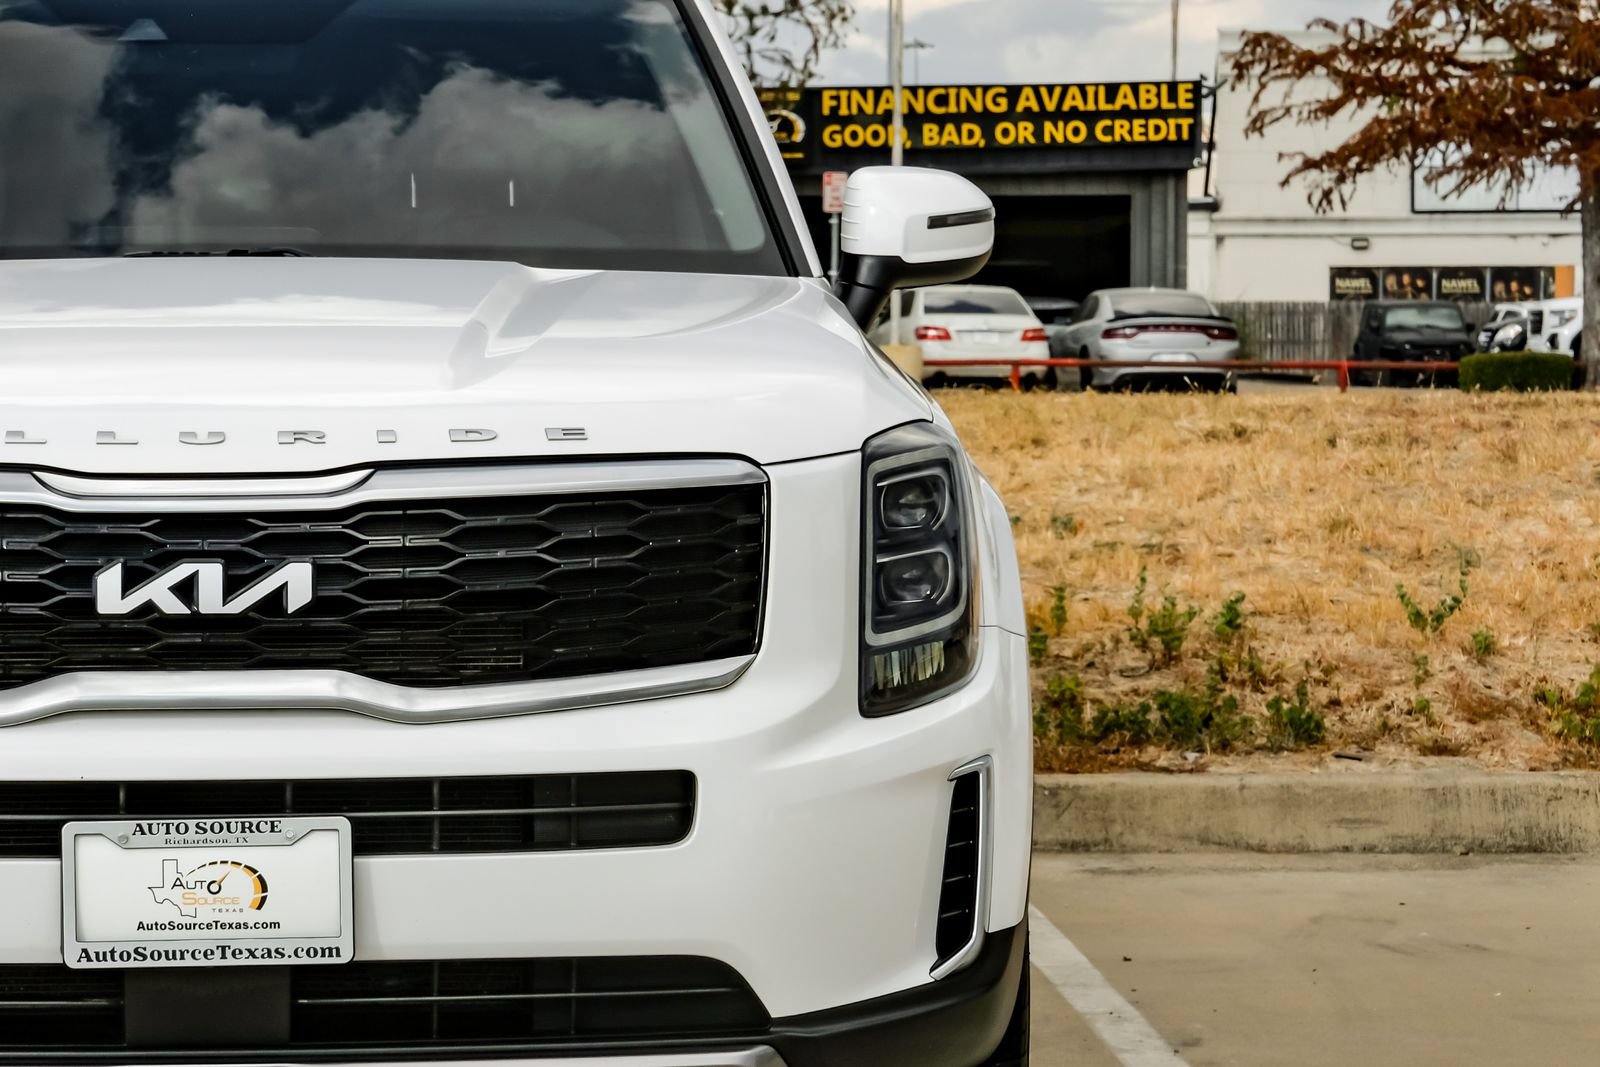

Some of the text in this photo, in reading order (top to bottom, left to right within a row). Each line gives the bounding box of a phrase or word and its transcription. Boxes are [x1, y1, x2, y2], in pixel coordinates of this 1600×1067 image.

[821, 82, 1194, 116] FINANCING AVAILABLE
[922, 122, 986, 148] BAD,
[994, 120, 1036, 145] OR
[1043, 119, 1088, 144] NO
[1094, 117, 1194, 143] CREDIT
[95, 561, 314, 615] KIA
[132, 819, 282, 836] AUTO SOURCE
[234, 836, 249, 844] TX
[136, 920, 281, 932] AutoSourceTexas.com
[76, 945, 342, 964] AutoSourceTexas.com
